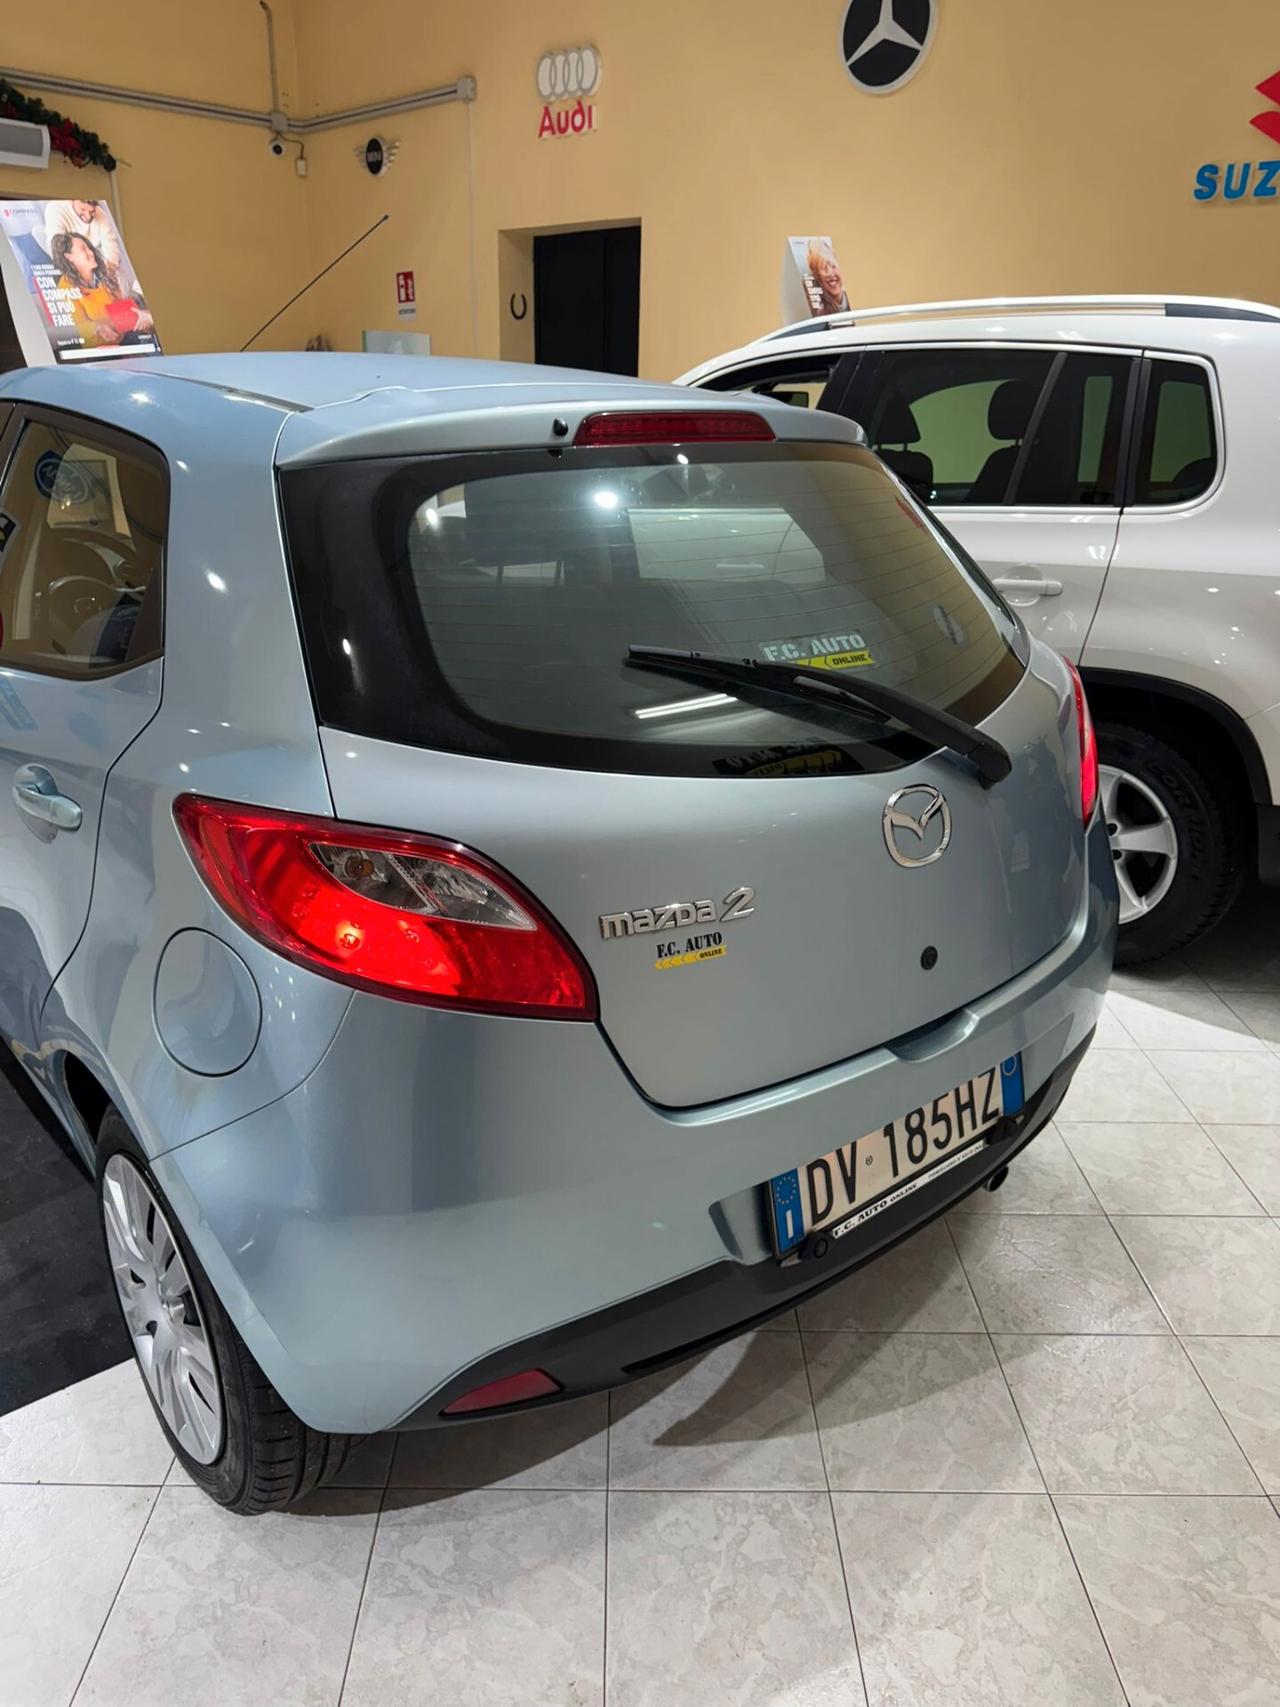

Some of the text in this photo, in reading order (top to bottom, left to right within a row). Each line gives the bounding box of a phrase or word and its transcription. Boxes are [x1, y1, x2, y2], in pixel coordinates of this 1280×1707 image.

[539, 100, 592, 138] Audi
[1193, 160, 1280, 201] SUZ
[37, 276, 56, 289] CON
[42, 287, 83, 301] COMPASS
[52, 313, 76, 327] FARE
[763, 633, 866, 661] F.C. AUTO
[831, 653, 868, 666] ONLINE
[719, 886, 755, 923] 2
[656, 931, 723, 959] F.C. AUTO
[699, 947, 722, 959] ONLINE
[806, 1066, 1000, 1226] DV 185HZ
[857, 1200, 888, 1222] AUTO
